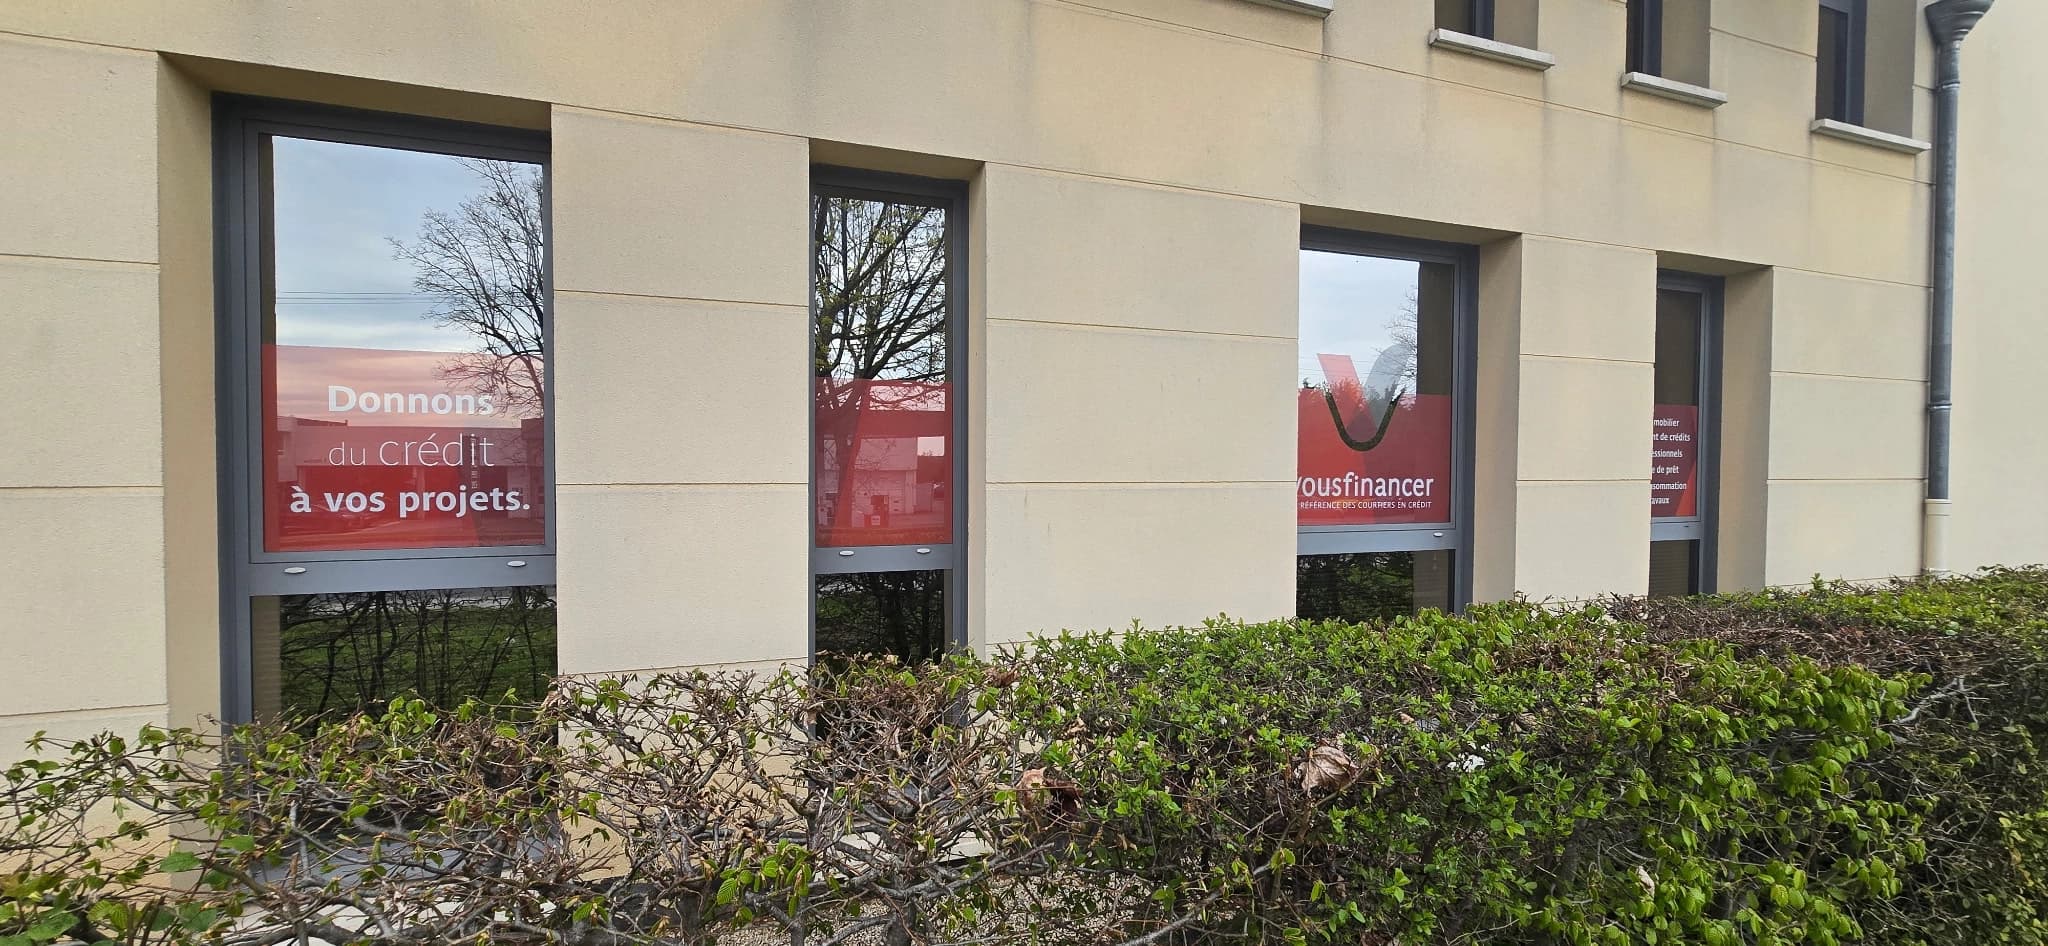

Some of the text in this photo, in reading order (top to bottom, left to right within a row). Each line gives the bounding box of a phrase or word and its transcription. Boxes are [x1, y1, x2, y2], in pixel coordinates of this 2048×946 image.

[328, 385, 494, 415] Donnons
[1660, 432, 1669, 441] de
[1669, 432, 1691, 442] crédits
[328, 432, 495, 467] du crédit
[1657, 465, 1665, 474] de
[1666, 465, 1680, 475] prêt
[290, 485, 531, 518] à vos projets.
[1342, 500, 1356, 509] DES
[1357, 500, 1396, 509] COURTIERS
[1397, 500, 1406, 509] EN
[1408, 499, 1432, 509] CRÉDIT
